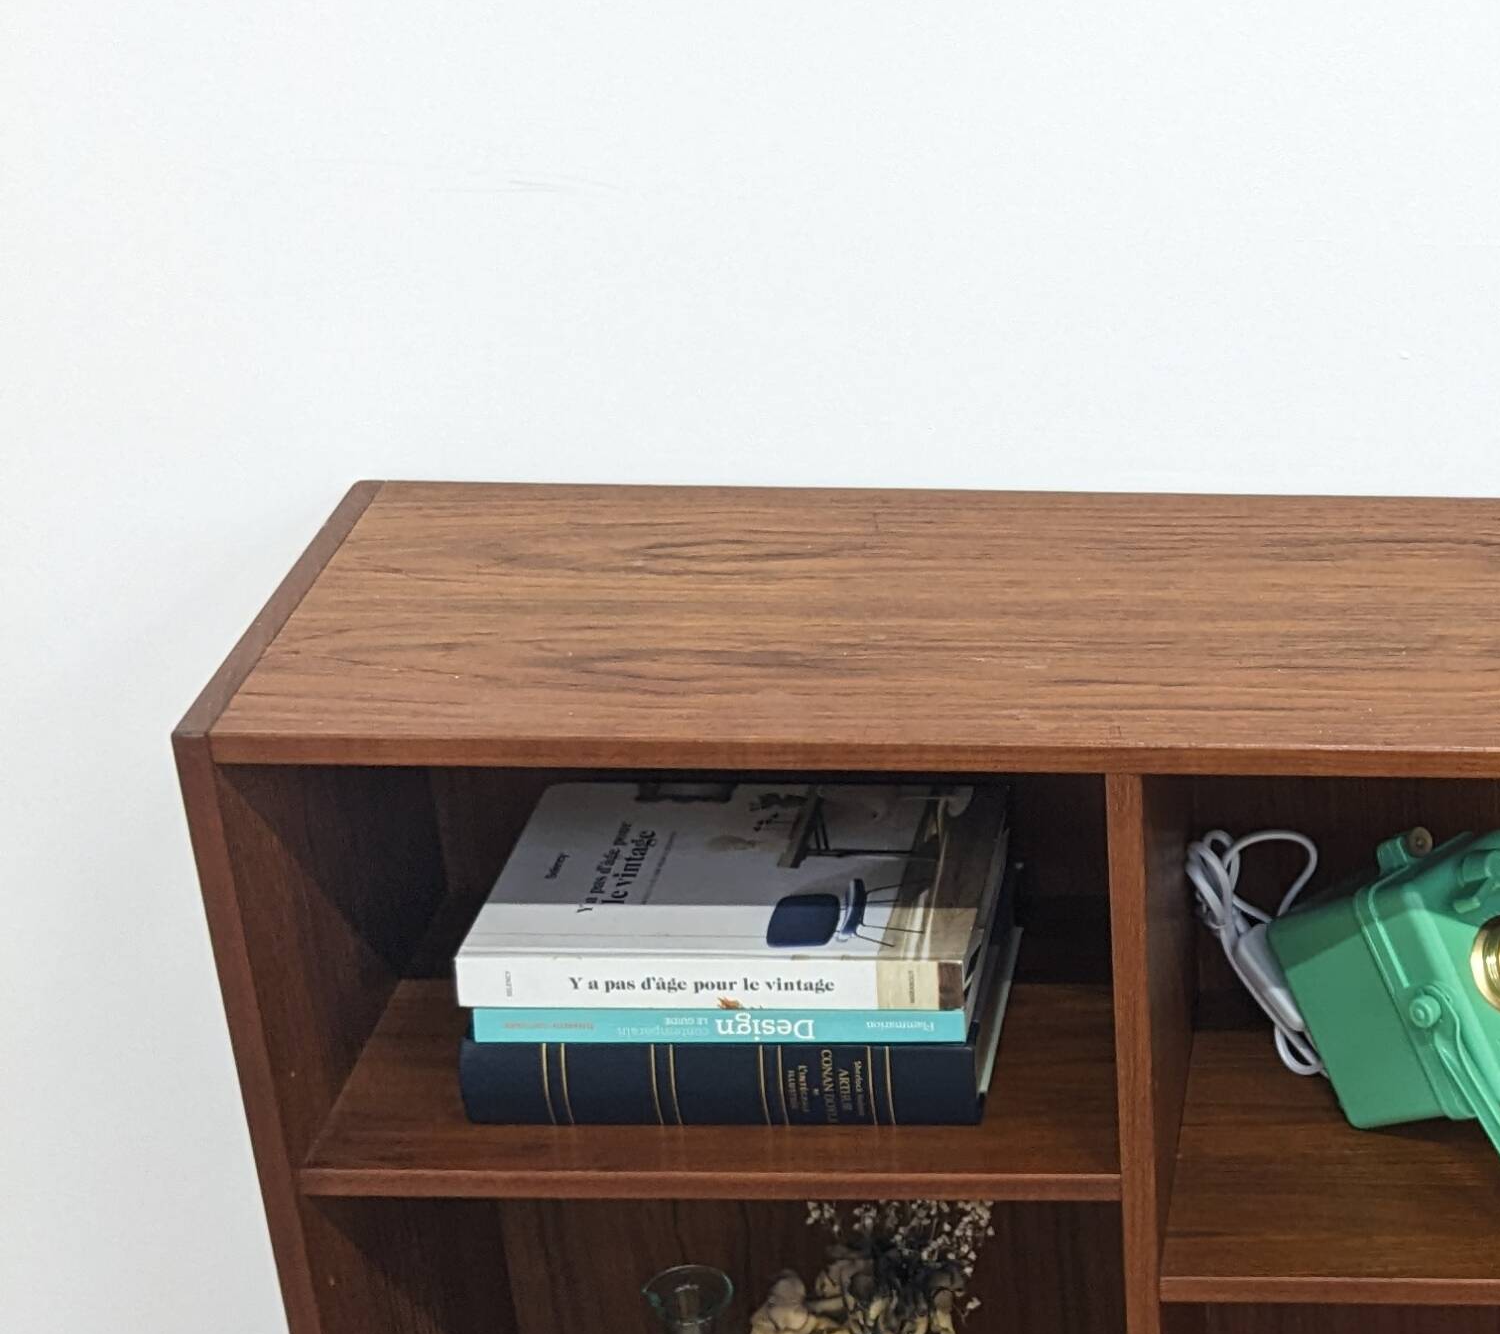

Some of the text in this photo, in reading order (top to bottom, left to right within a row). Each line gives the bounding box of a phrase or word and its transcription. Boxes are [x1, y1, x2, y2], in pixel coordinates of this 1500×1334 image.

[601, 829, 657, 905] le vintage
[569, 975, 835, 994] Y a pas d'âge pour le vintage
[616, 1025, 710, 1037] contemporain
[664, 1017, 696, 1025] GUIDE
[715, 1012, 815, 1041] Design
[866, 1020, 935, 1032] Flammarion
[821, 1049, 835, 1092] CONAN
[838, 1068, 853, 1111] ARTHUR
